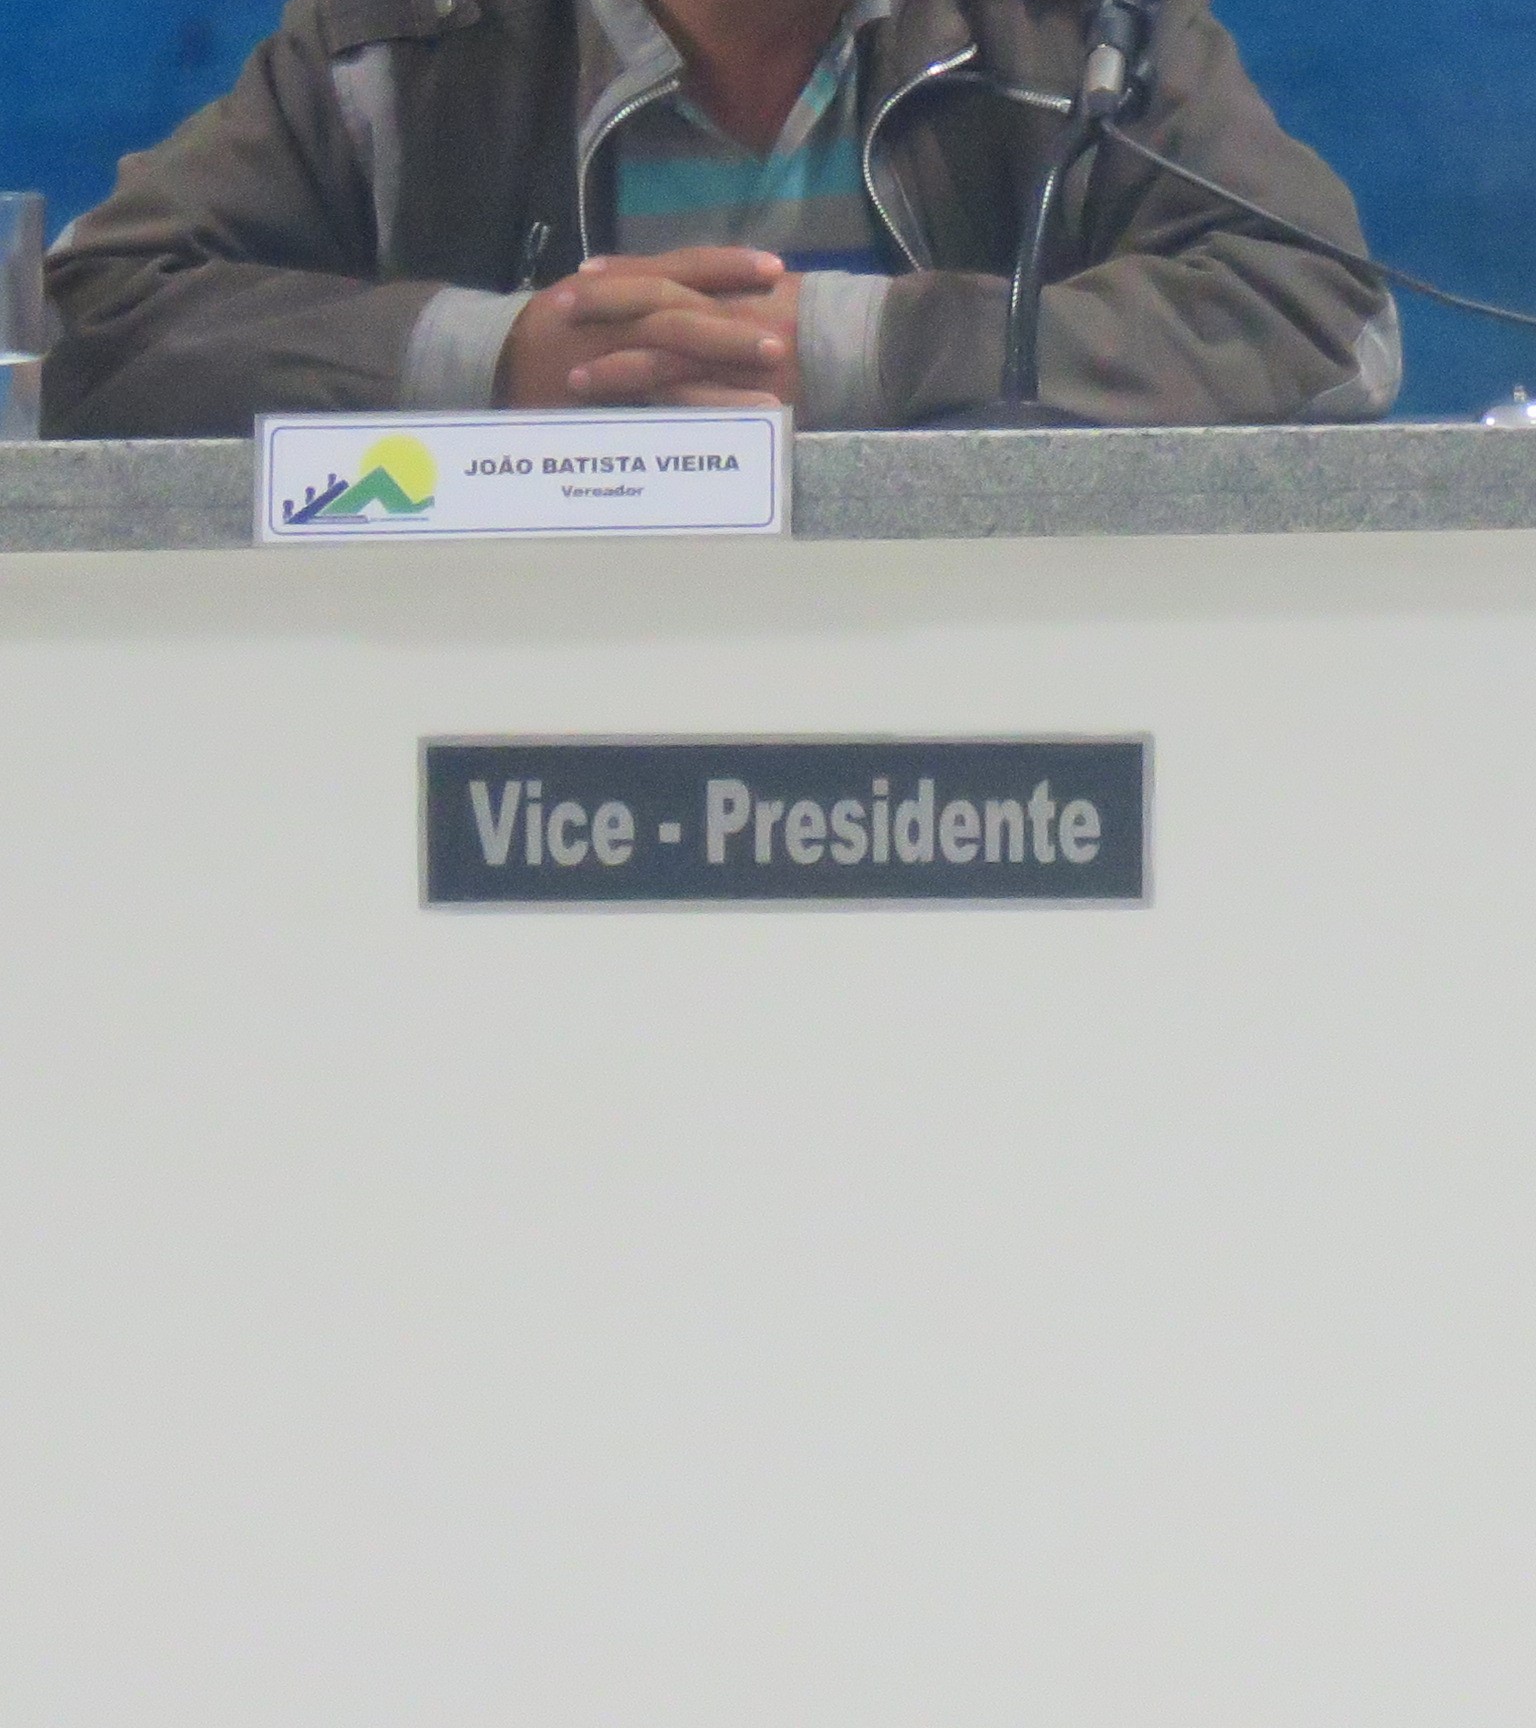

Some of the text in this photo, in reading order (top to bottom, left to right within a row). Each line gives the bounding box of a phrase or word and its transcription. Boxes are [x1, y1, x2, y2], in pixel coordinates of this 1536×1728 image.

[464, 454, 740, 475] JOÃO BATISTA VIEIRA
[561, 484, 644, 497] Vereador
[469, 777, 1101, 866] Vice - Presidente
